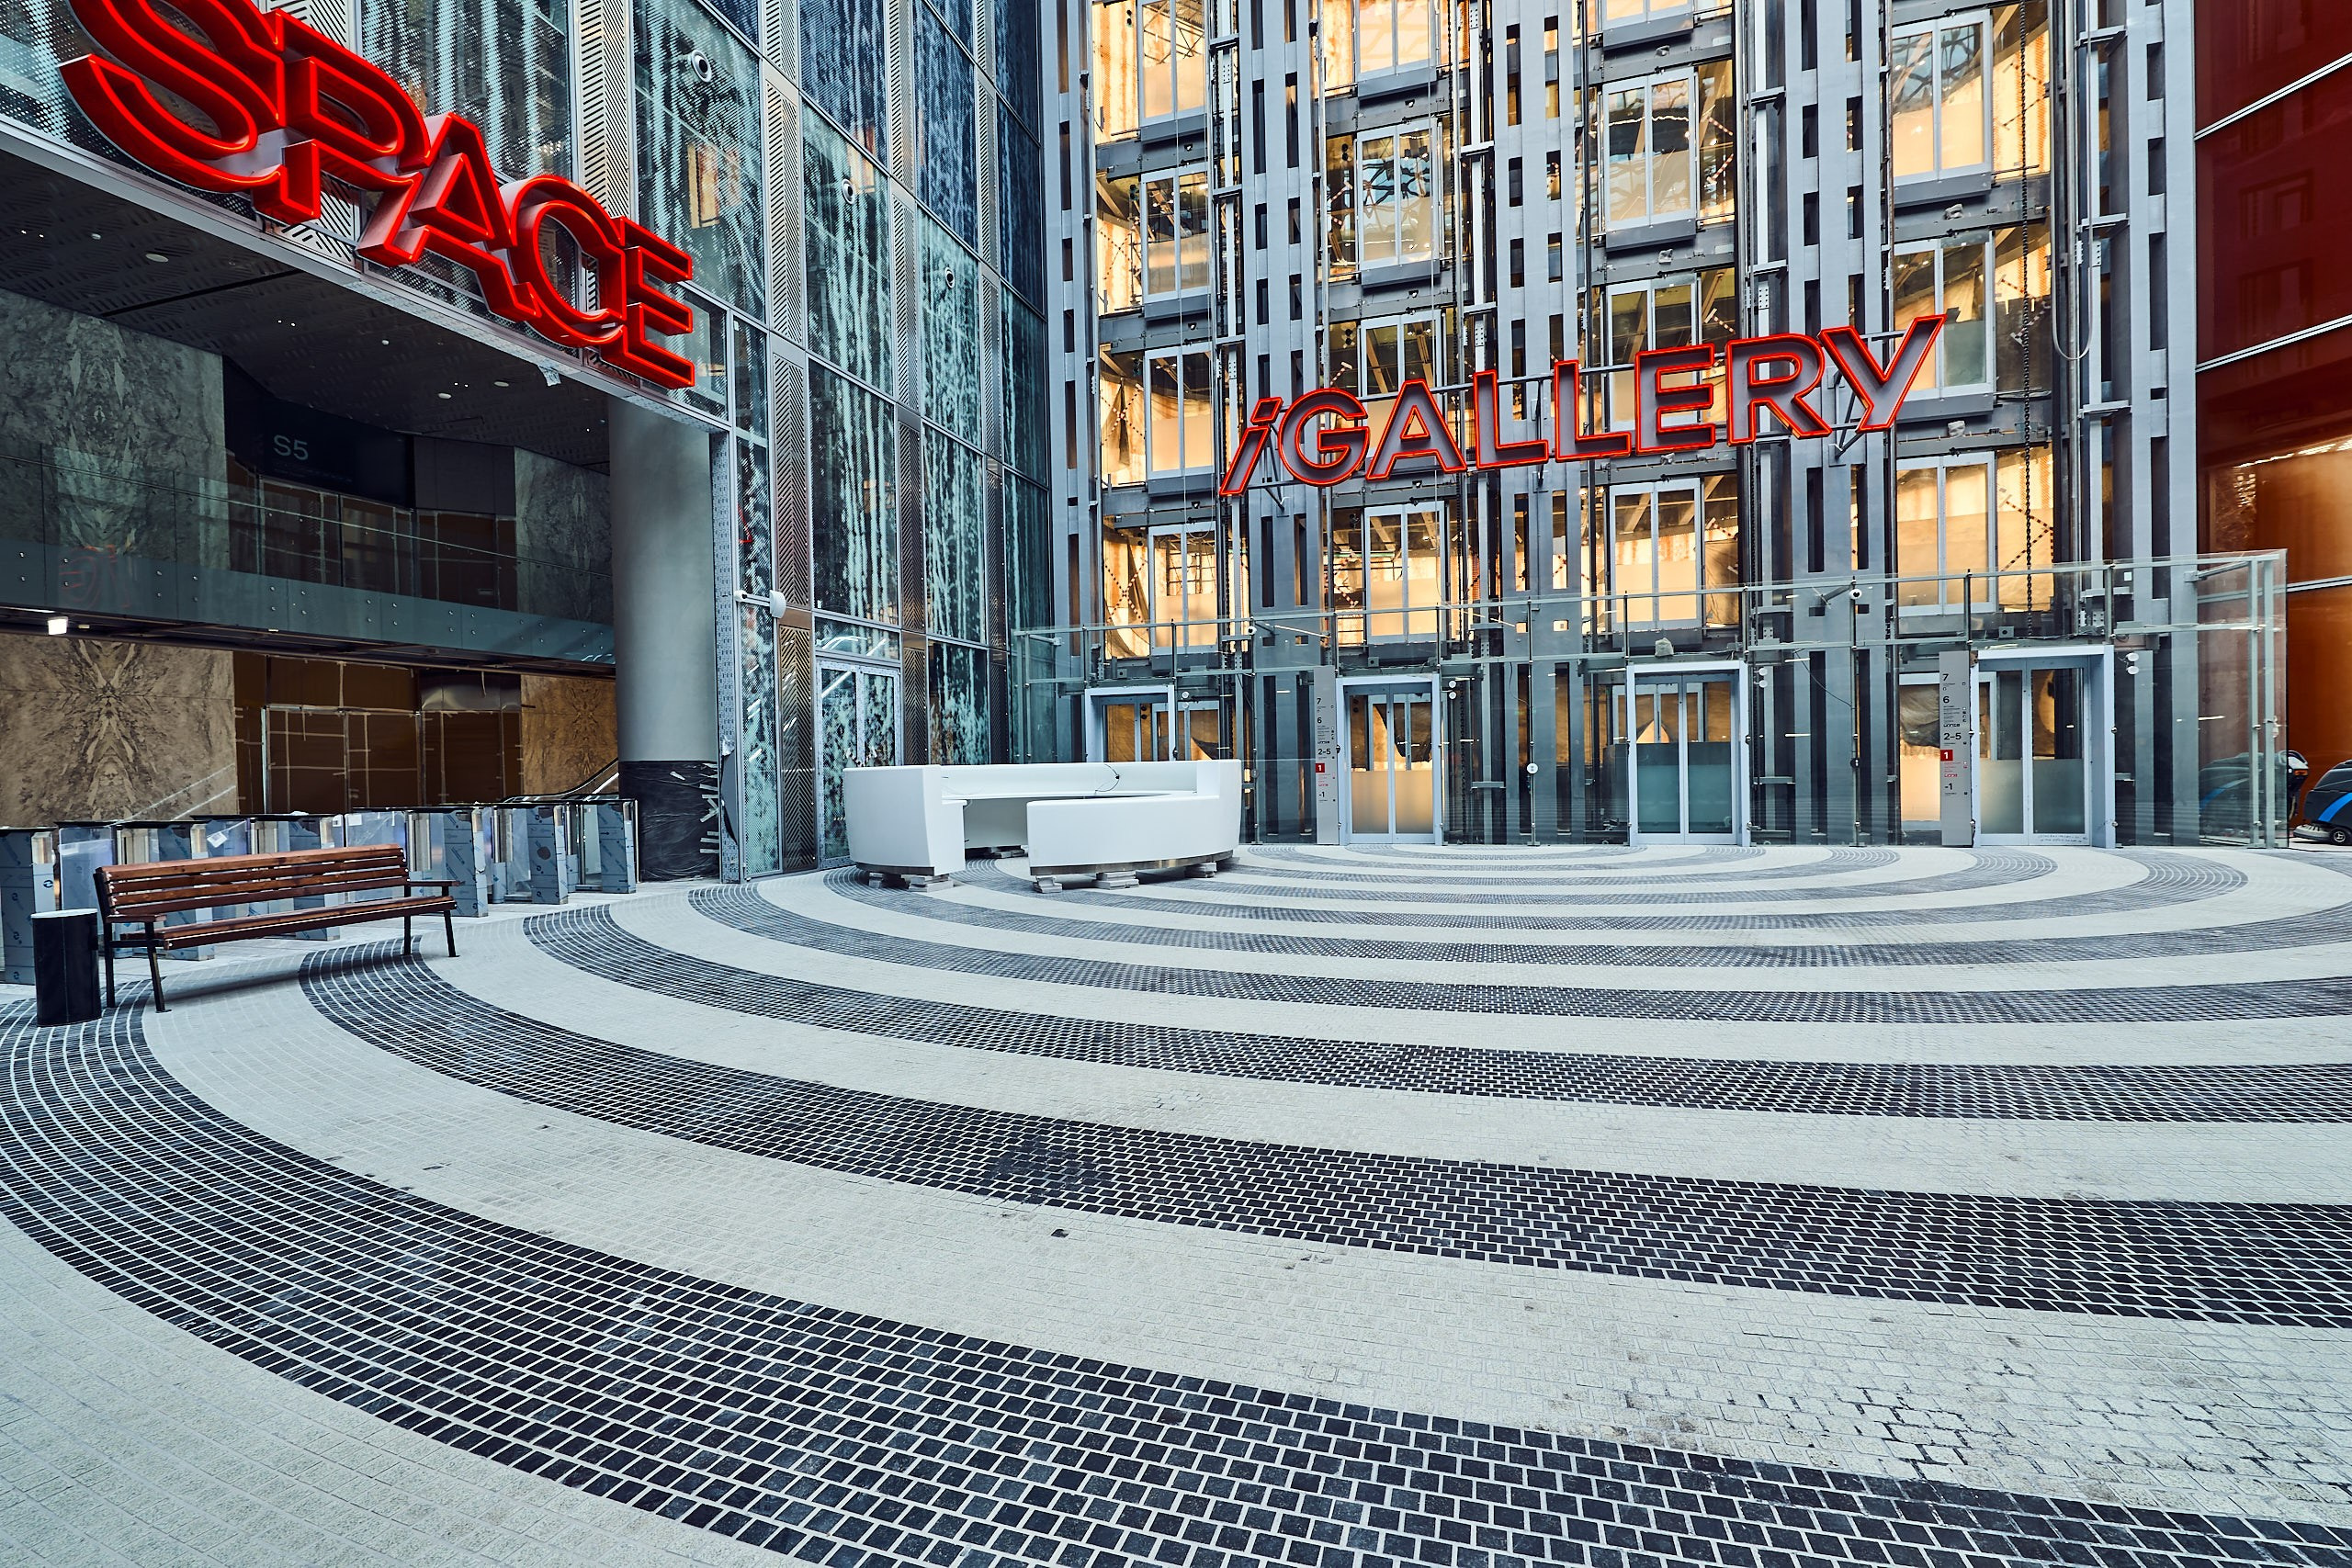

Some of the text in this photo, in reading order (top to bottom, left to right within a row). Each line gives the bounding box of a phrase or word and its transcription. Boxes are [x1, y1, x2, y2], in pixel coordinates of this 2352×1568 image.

[59, 0, 695, 389] SPACE
[273, 434, 309, 461] S5
[1942, 673, 1950, 682] 7
[1942, 695, 1950, 704] 6
[1943, 751, 1949, 760] 1
[1944, 783, 1953, 791] -1
